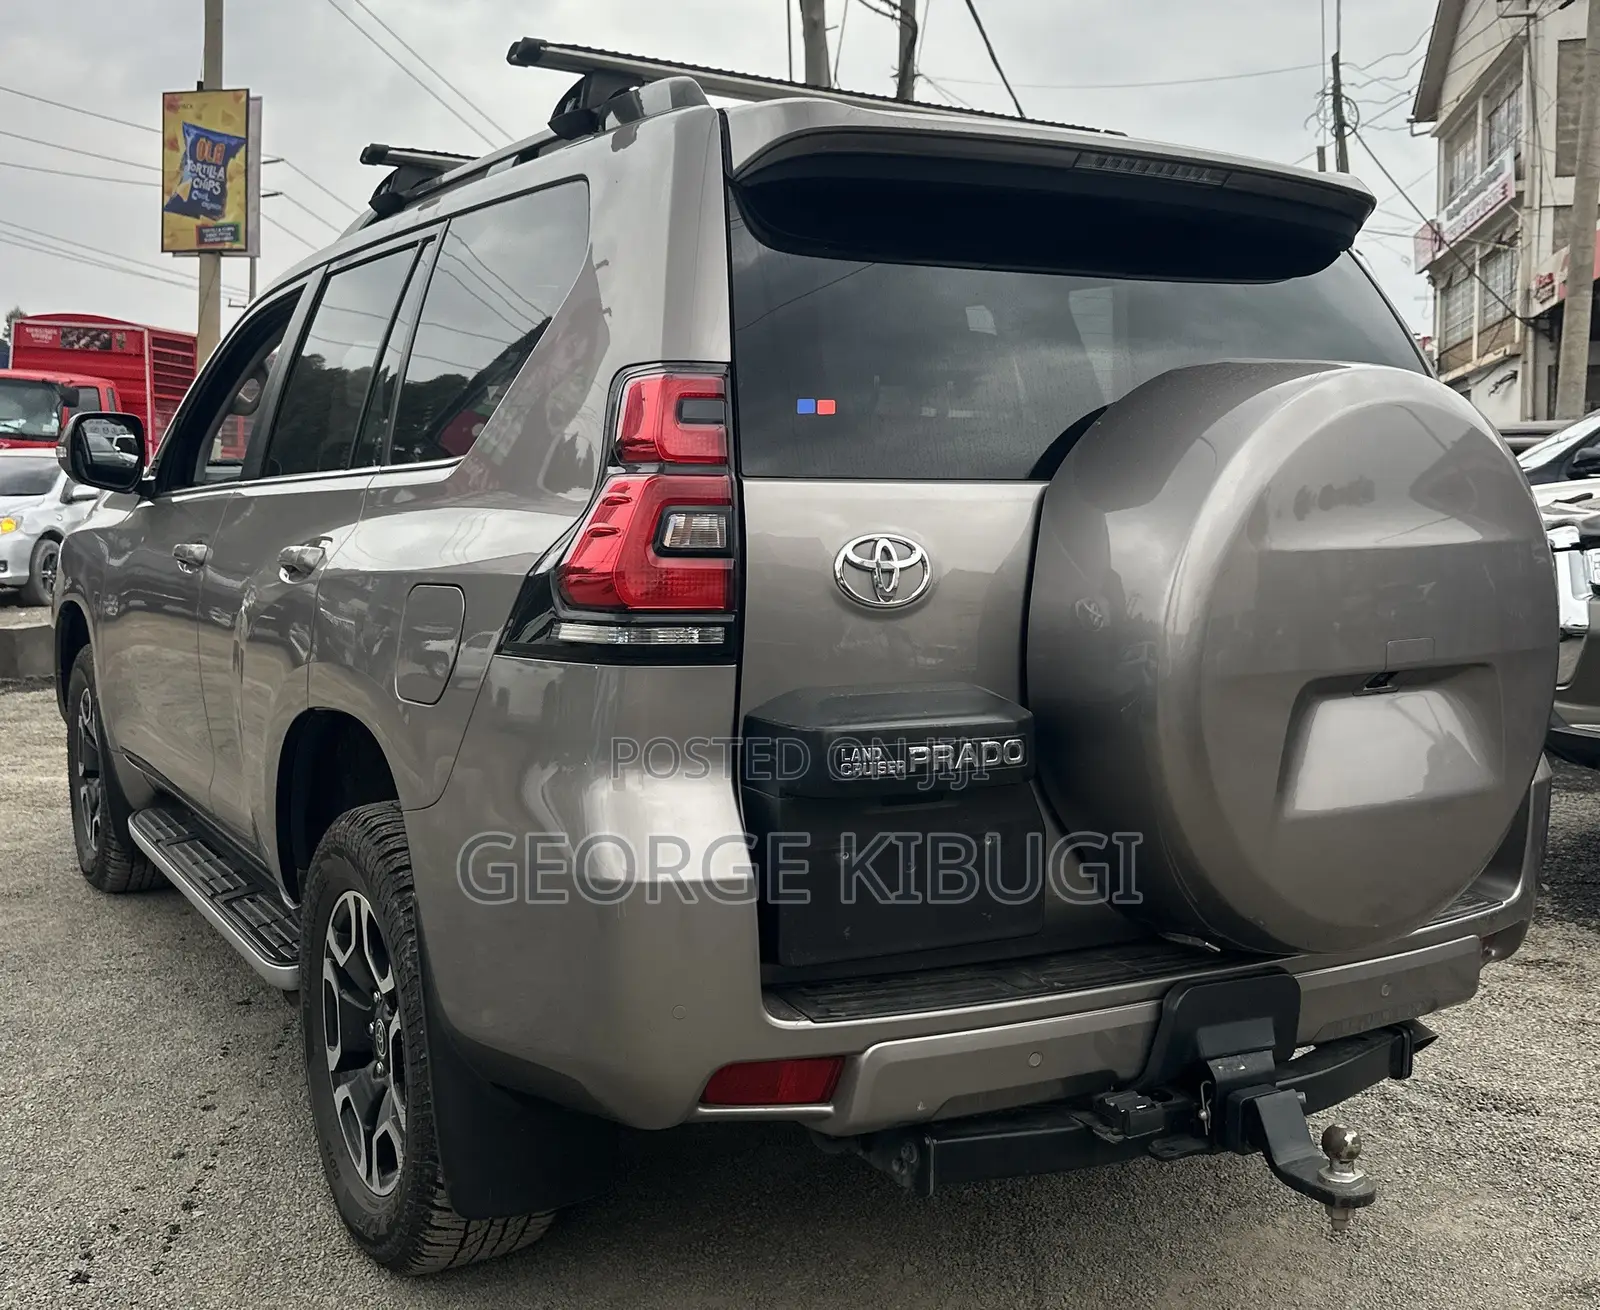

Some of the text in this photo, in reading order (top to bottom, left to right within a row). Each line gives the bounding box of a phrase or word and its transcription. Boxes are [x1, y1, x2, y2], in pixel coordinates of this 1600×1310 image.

[196, 138, 225, 165] OLA
[185, 159, 225, 181] TORTILLA
[841, 747, 882, 762] LAND
[908, 738, 1024, 773] PRADO
[840, 760, 906, 777] CRUISER
